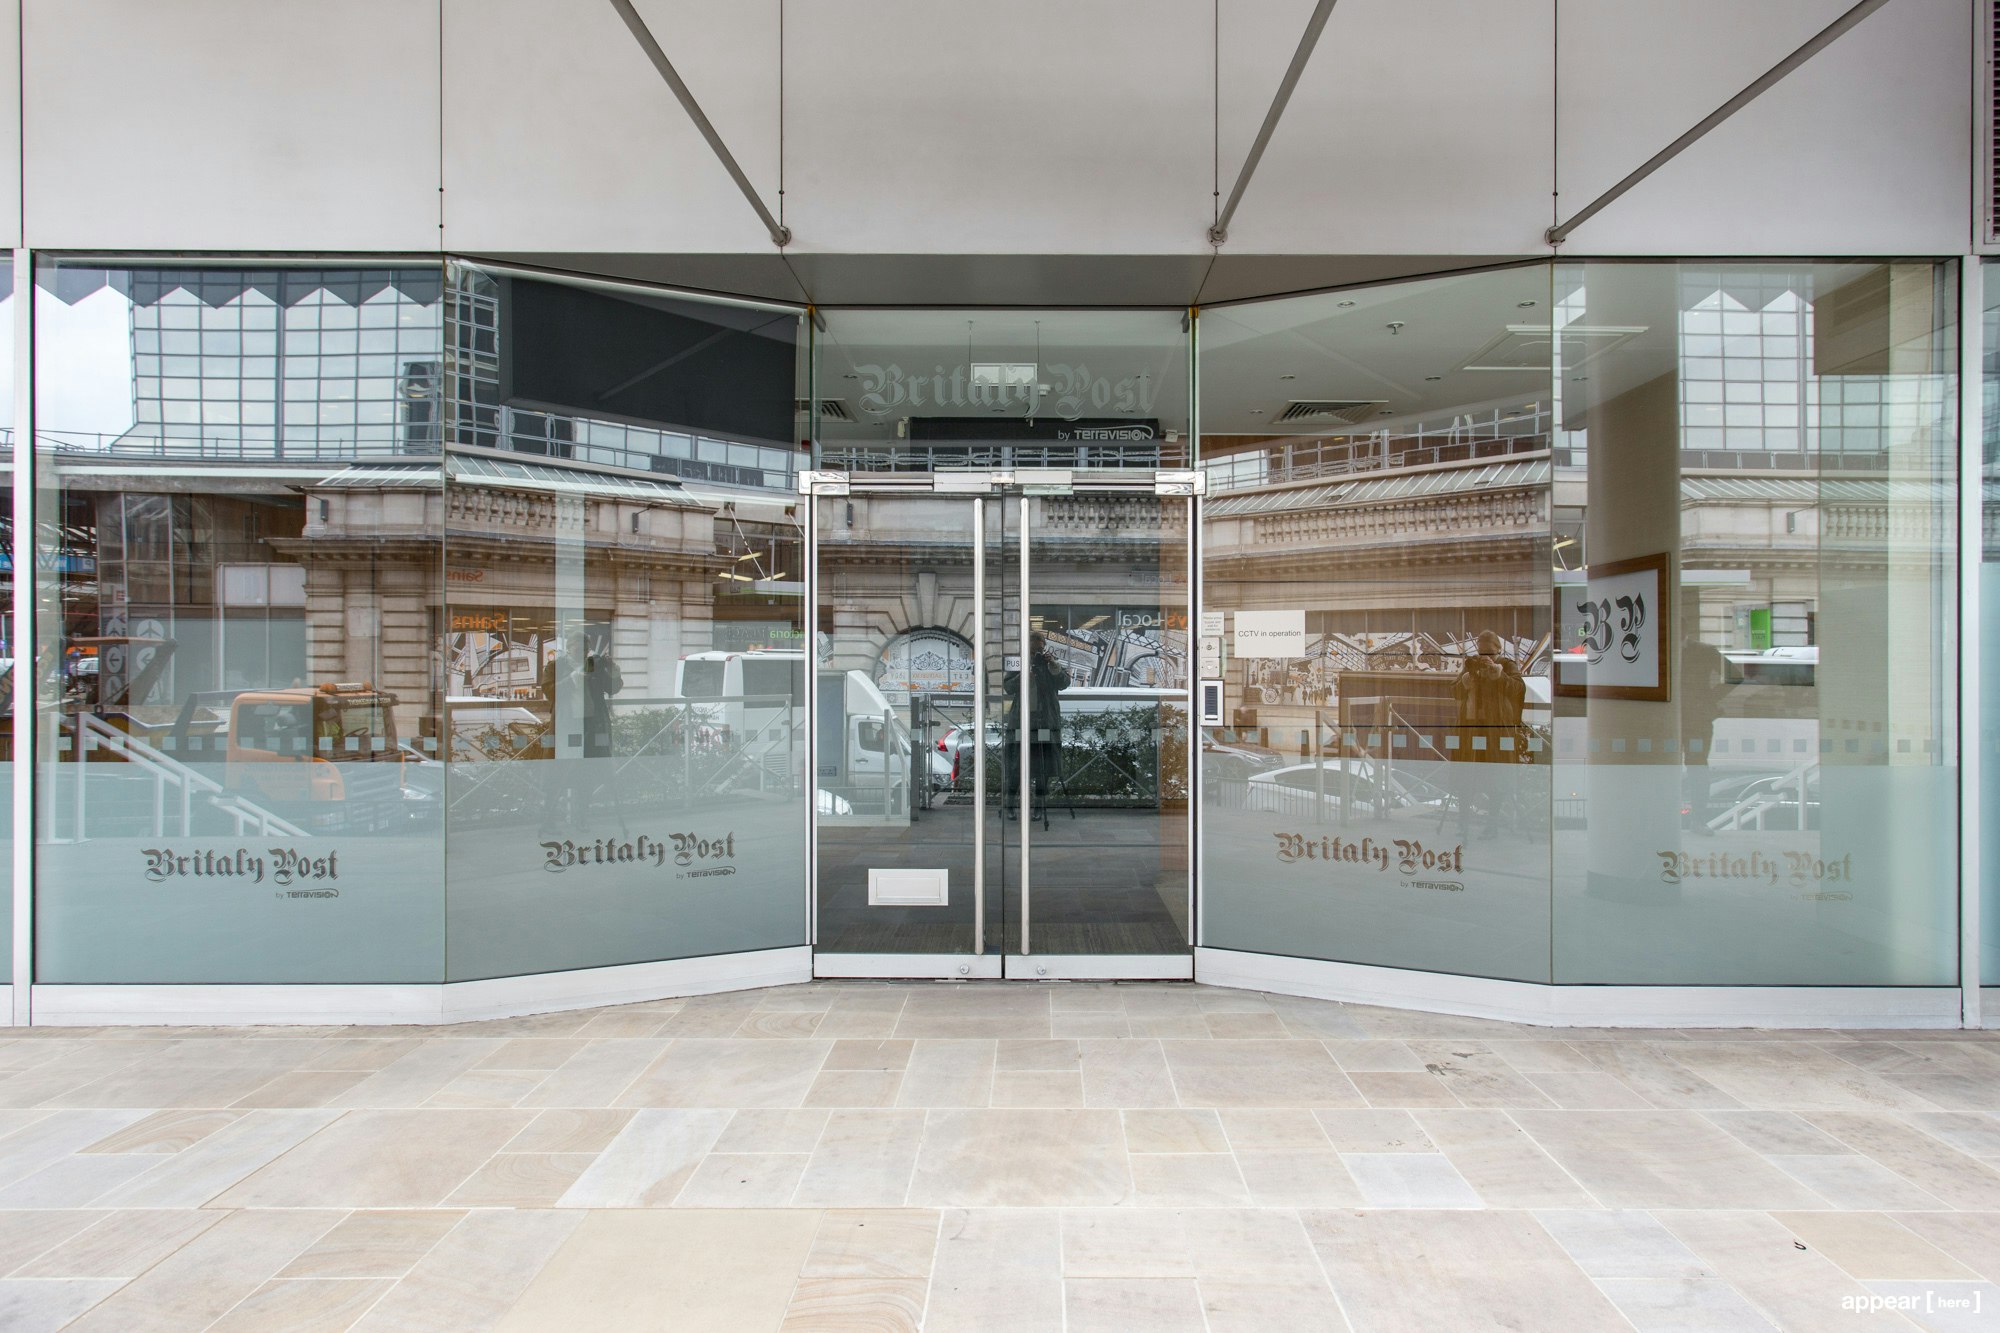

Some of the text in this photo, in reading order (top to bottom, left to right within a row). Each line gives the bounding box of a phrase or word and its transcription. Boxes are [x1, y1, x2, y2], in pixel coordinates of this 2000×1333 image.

[1046, 363, 1153, 421] Post
[1057, 430, 1070, 442] by
[1268, 630, 1302, 638] operation
[1006, 660, 1020, 668] PUS
[669, 831, 736, 867] Post
[1392, 839, 1465, 876] Post
[268, 848, 339, 886] Post
[1783, 850, 1853, 888] Post
[275, 891, 284, 900] by
[1400, 881, 1408, 889] by
